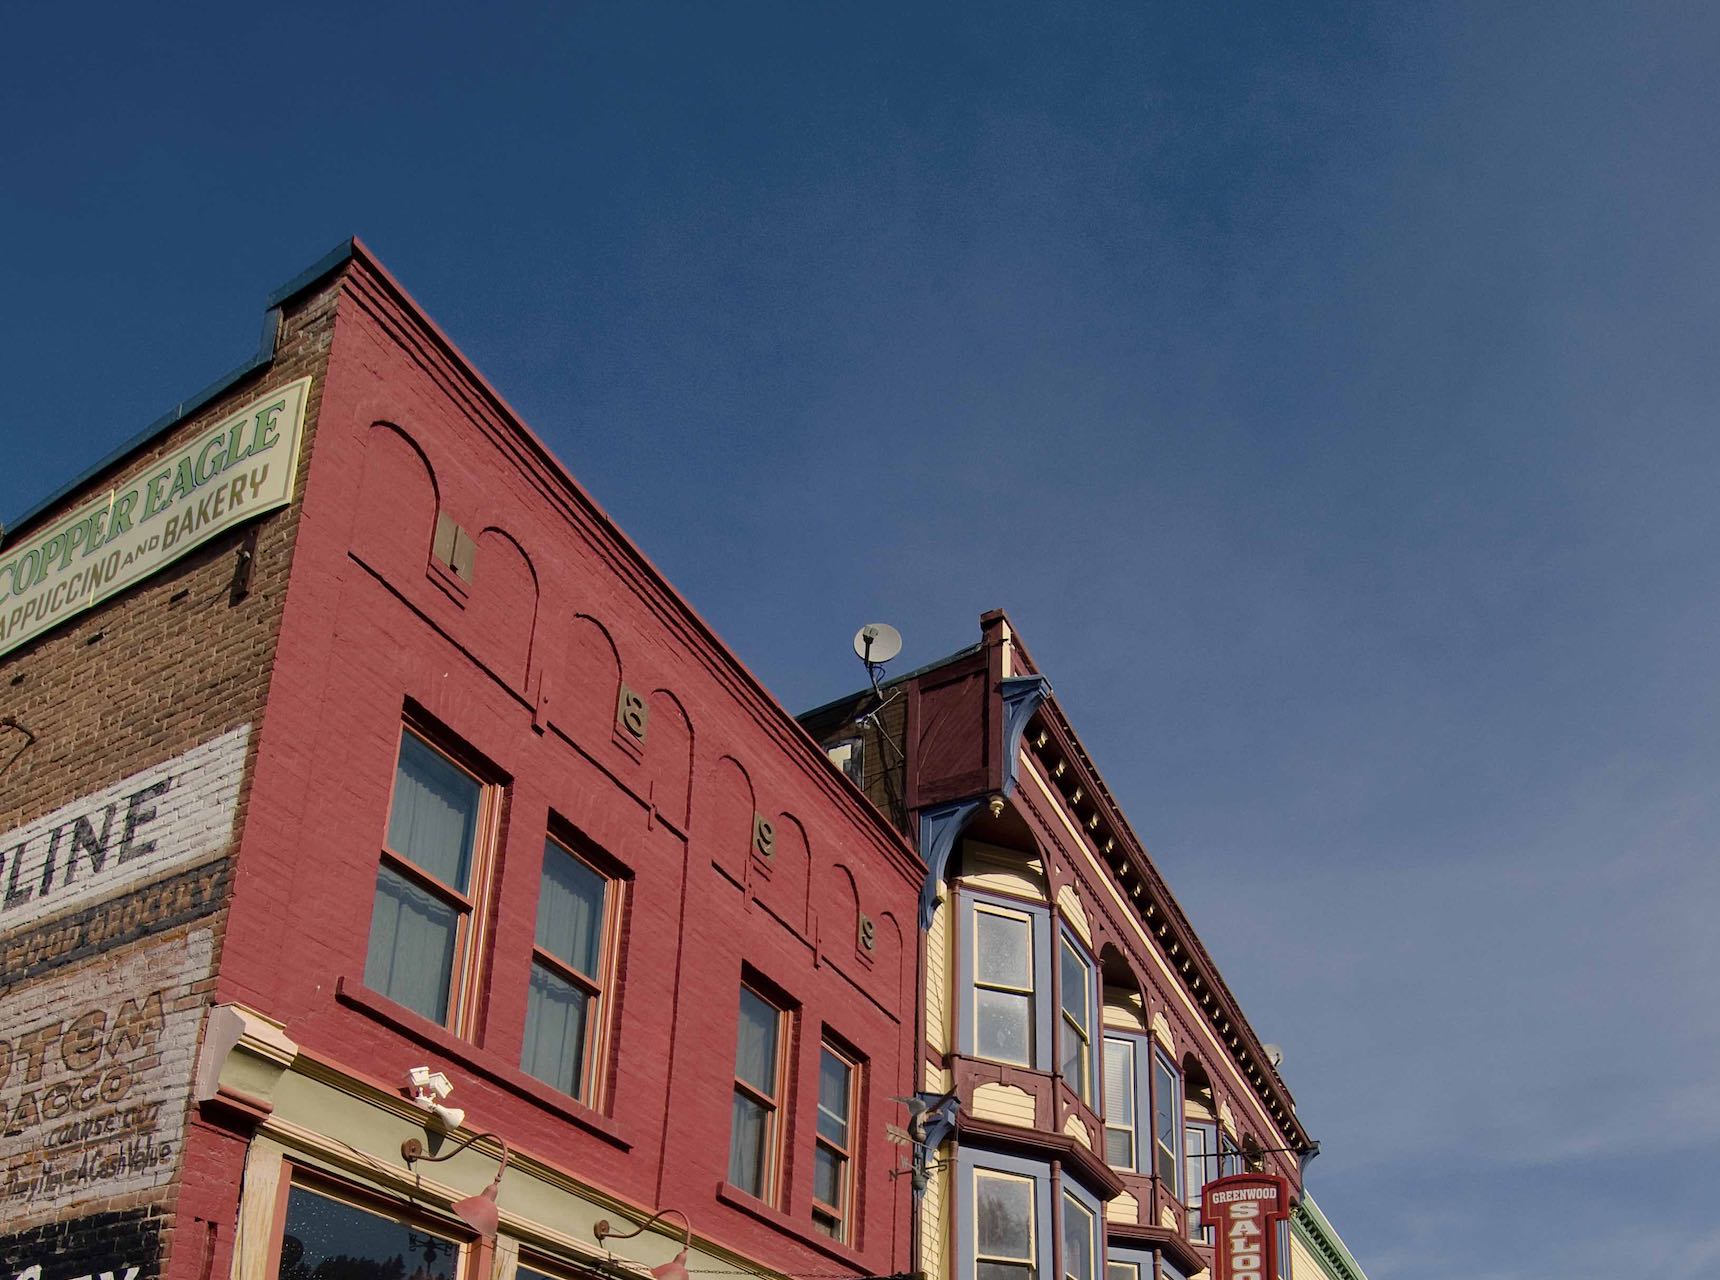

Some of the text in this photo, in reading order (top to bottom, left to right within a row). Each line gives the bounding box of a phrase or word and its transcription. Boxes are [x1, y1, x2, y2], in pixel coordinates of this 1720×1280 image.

[0, 400, 285, 606] COPPER EAGLE
[121, 534, 161, 570] AND
[162, 463, 270, 553] BAKERY
[0, 777, 173, 912] LINE
[1212, 1187, 1277, 1204] GREENWOOD
